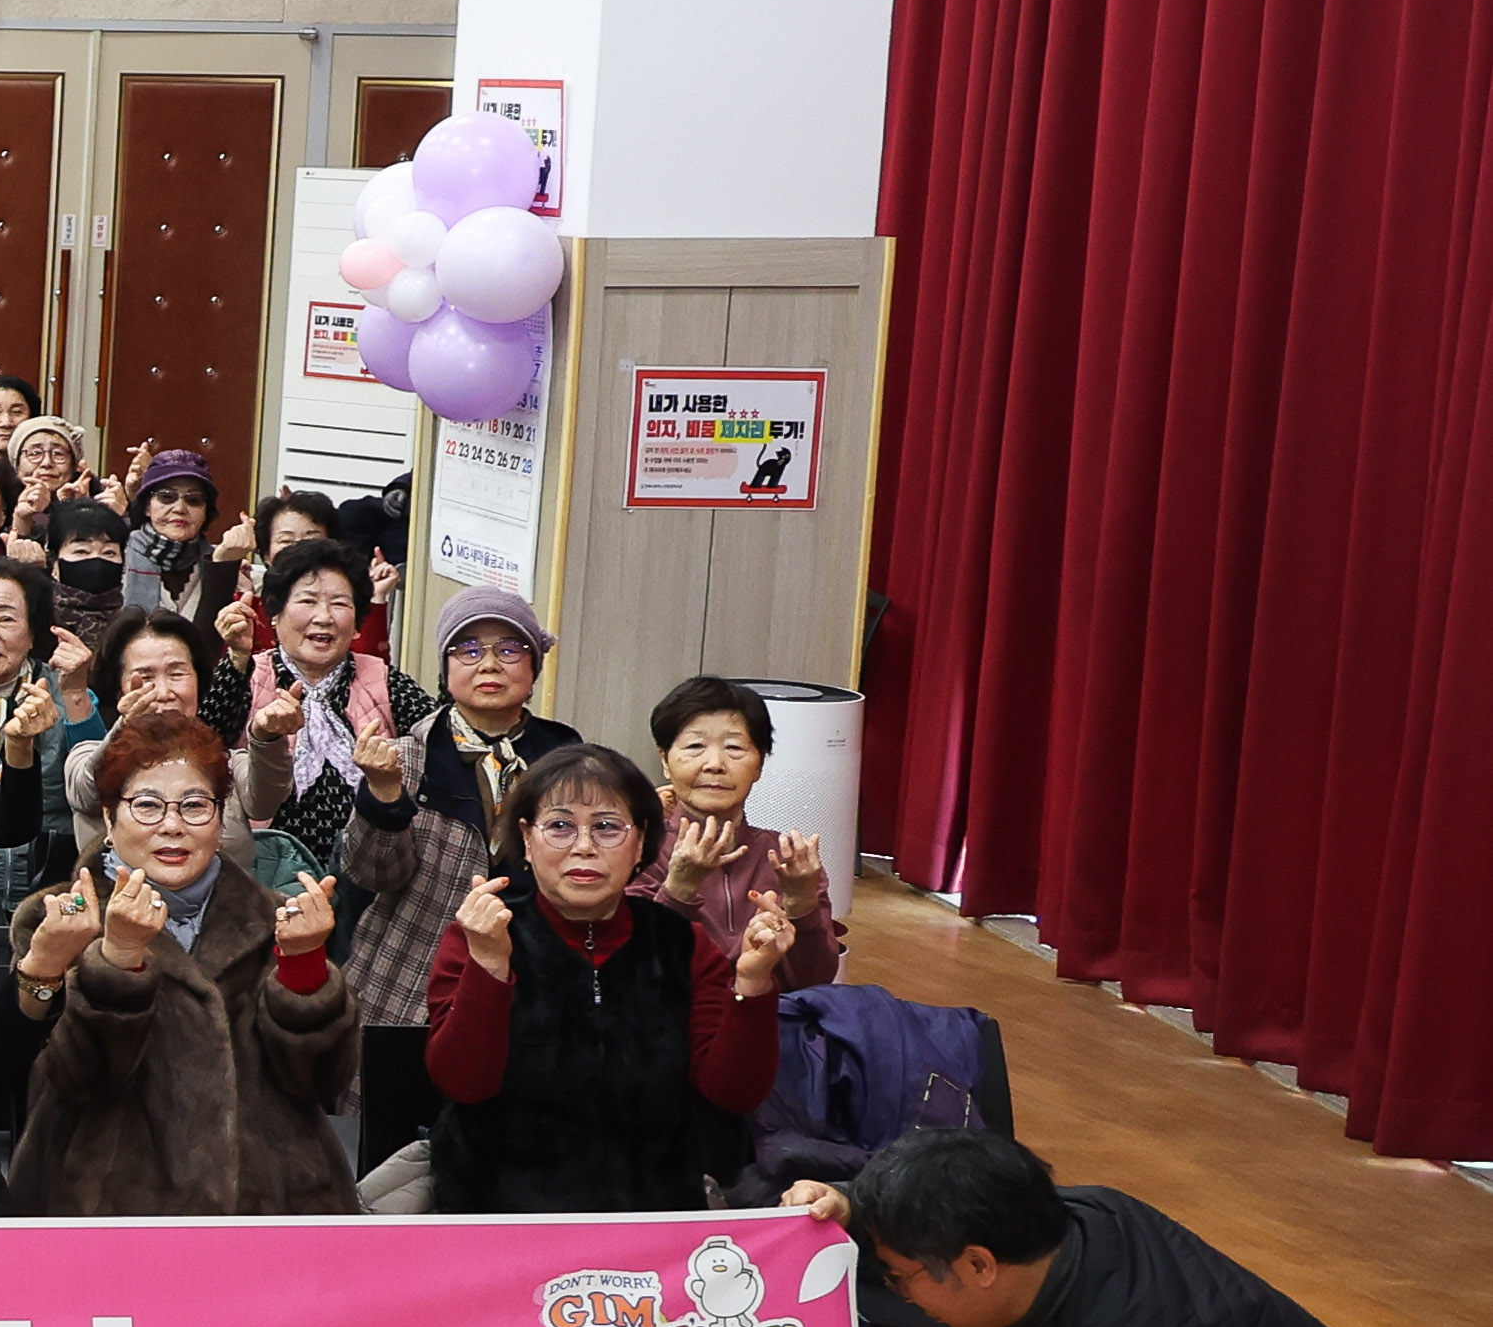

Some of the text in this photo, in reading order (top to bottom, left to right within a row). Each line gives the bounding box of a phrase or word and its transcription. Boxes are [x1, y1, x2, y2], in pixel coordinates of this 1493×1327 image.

[648, 394, 728, 413] 내가 사용한
[488, 419, 499, 434] 18
[500, 422, 512, 437] 19
[513, 424, 524, 440] 20
[525, 427, 536, 443] 21
[646, 419, 682, 440] 의자,
[719, 420, 765, 439] 제자리
[769, 421, 805, 440] 두기!
[445, 439, 533, 474] 22 23 24 25 26 27 28
[549, 1274, 596, 1296] DON'T
